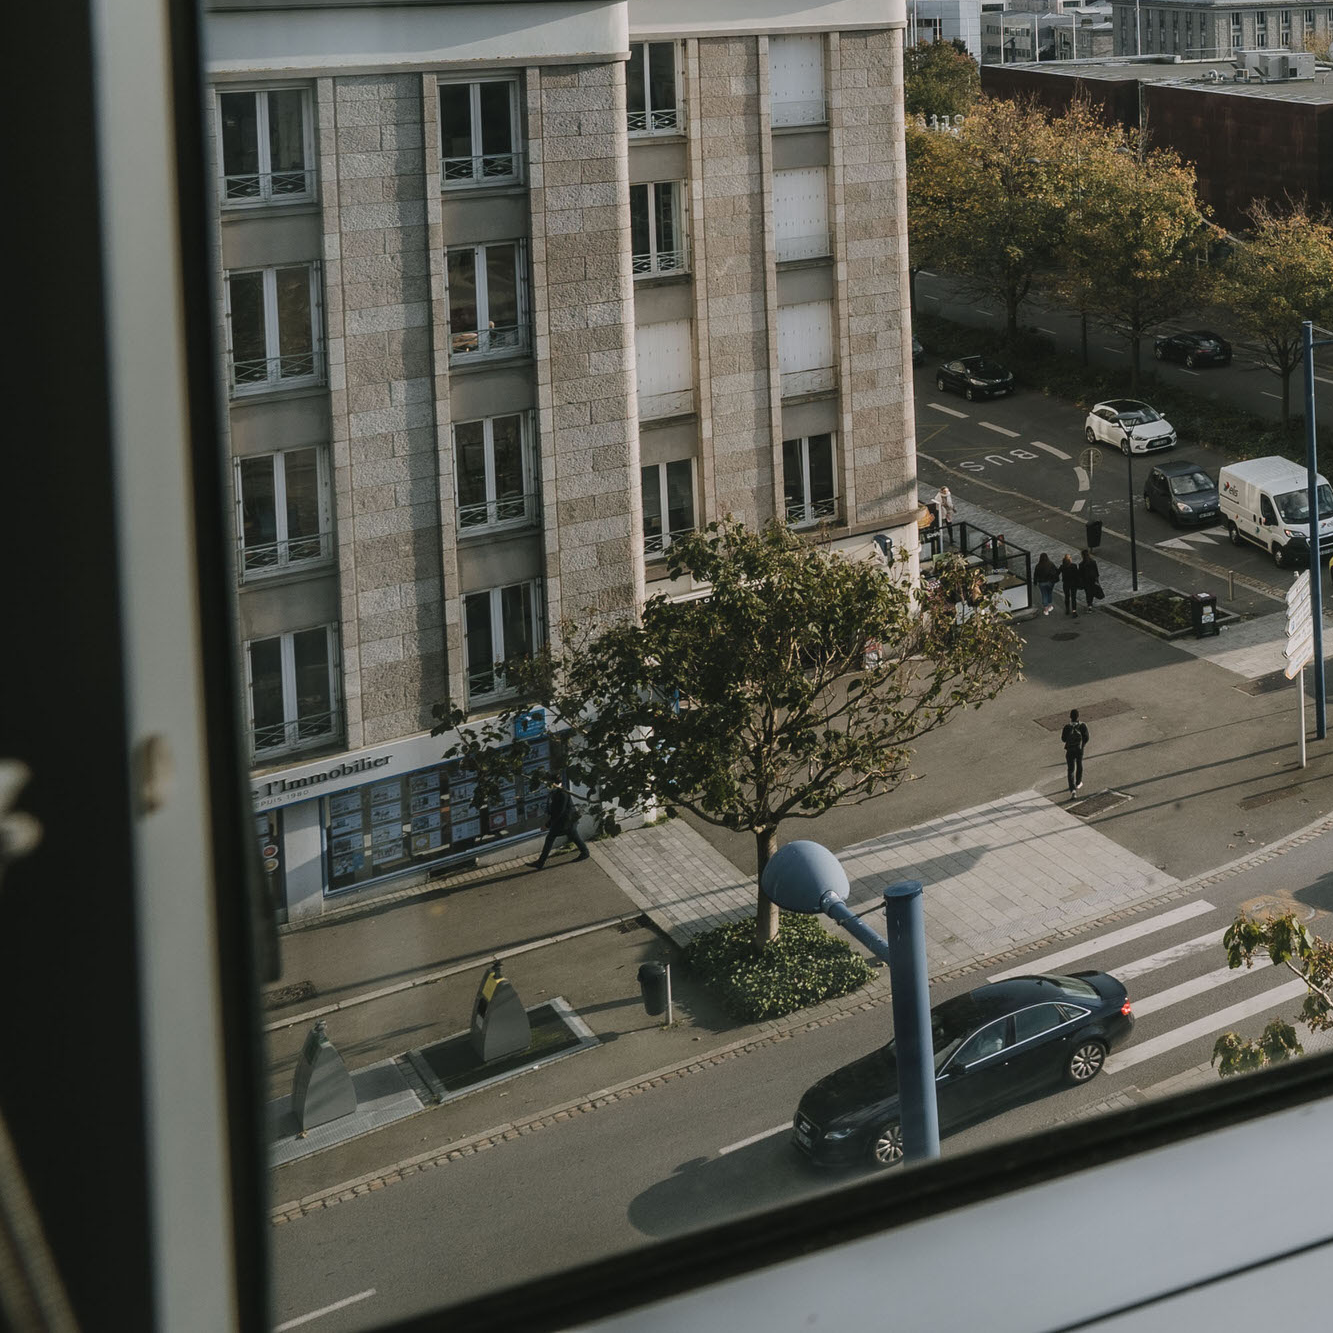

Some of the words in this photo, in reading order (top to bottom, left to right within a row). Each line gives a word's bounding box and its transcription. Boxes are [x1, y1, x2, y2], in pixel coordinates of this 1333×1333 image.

[960, 448, 1039, 472] BUS
[266, 755, 393, 797] l'Immobilier
[286, 789, 310, 801] 1980
